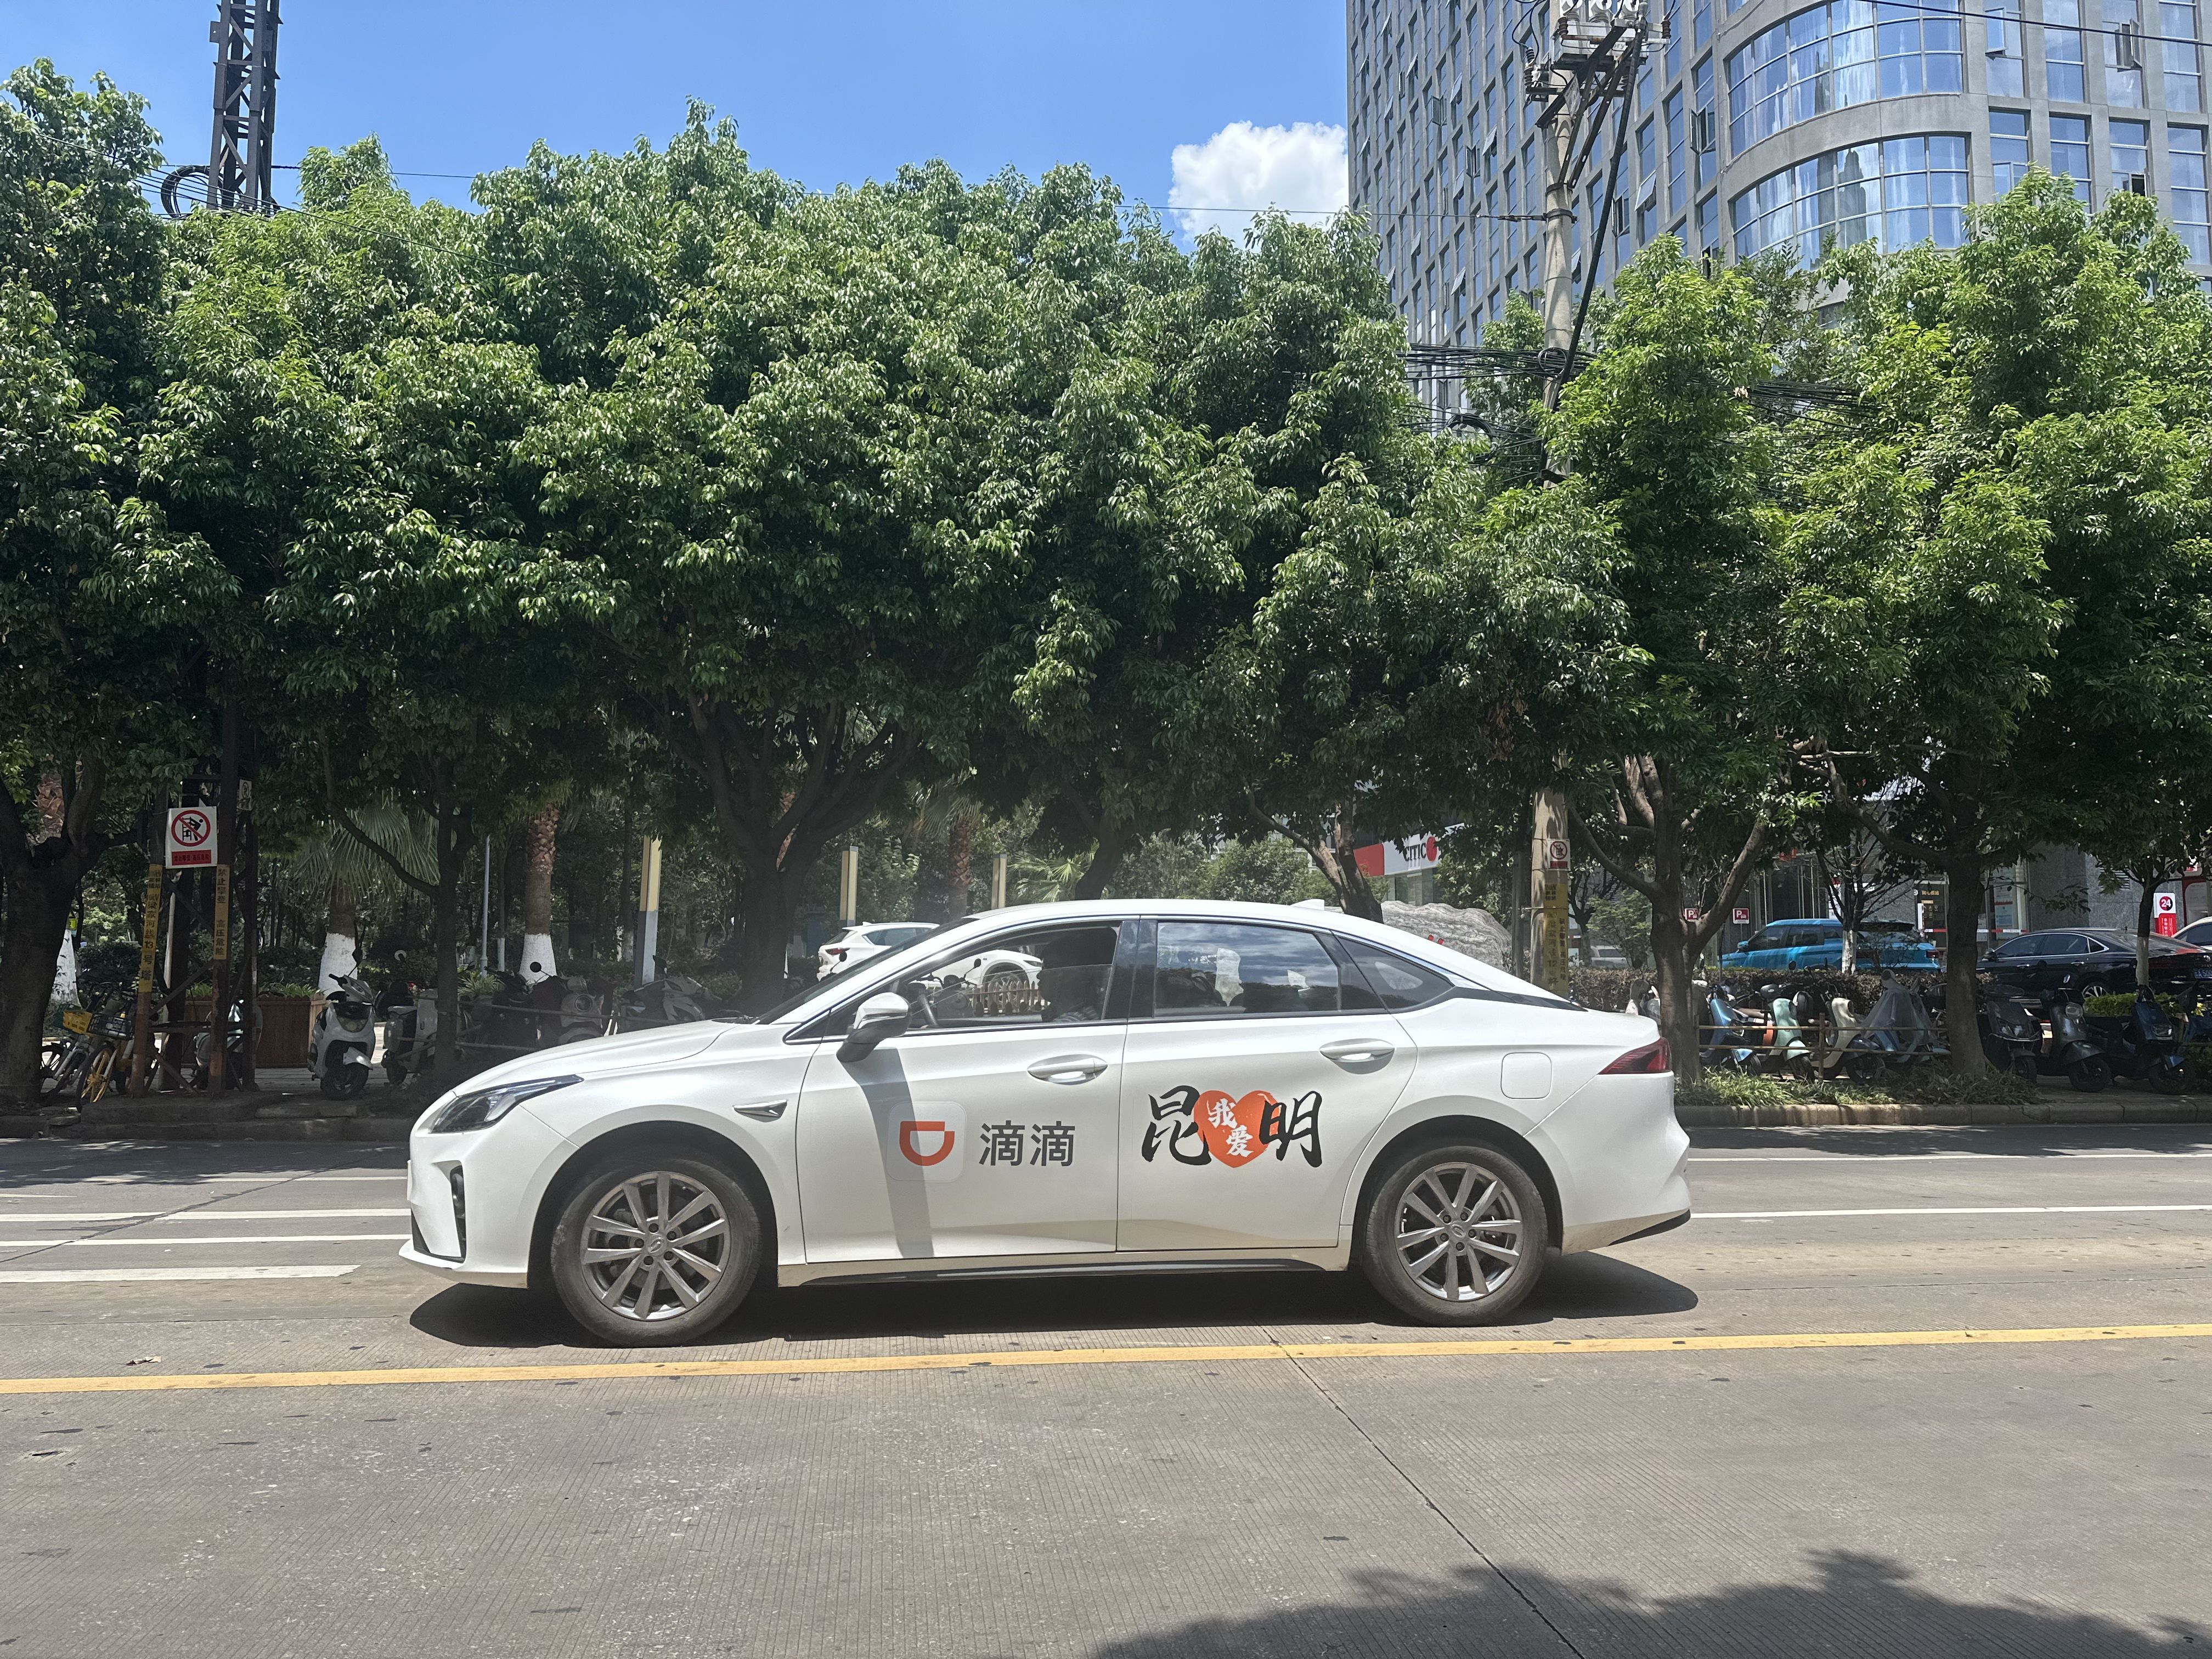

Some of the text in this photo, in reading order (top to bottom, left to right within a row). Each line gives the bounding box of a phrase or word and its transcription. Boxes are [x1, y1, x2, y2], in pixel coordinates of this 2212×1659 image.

[1403, 843, 1426, 861] CITIC
[2161, 899, 2171, 907] 24
[216, 919, 225, 955] 高压危险
[979, 1120, 1075, 1166] 滴滴
[1207, 1098, 1254, 1158] 我爱
